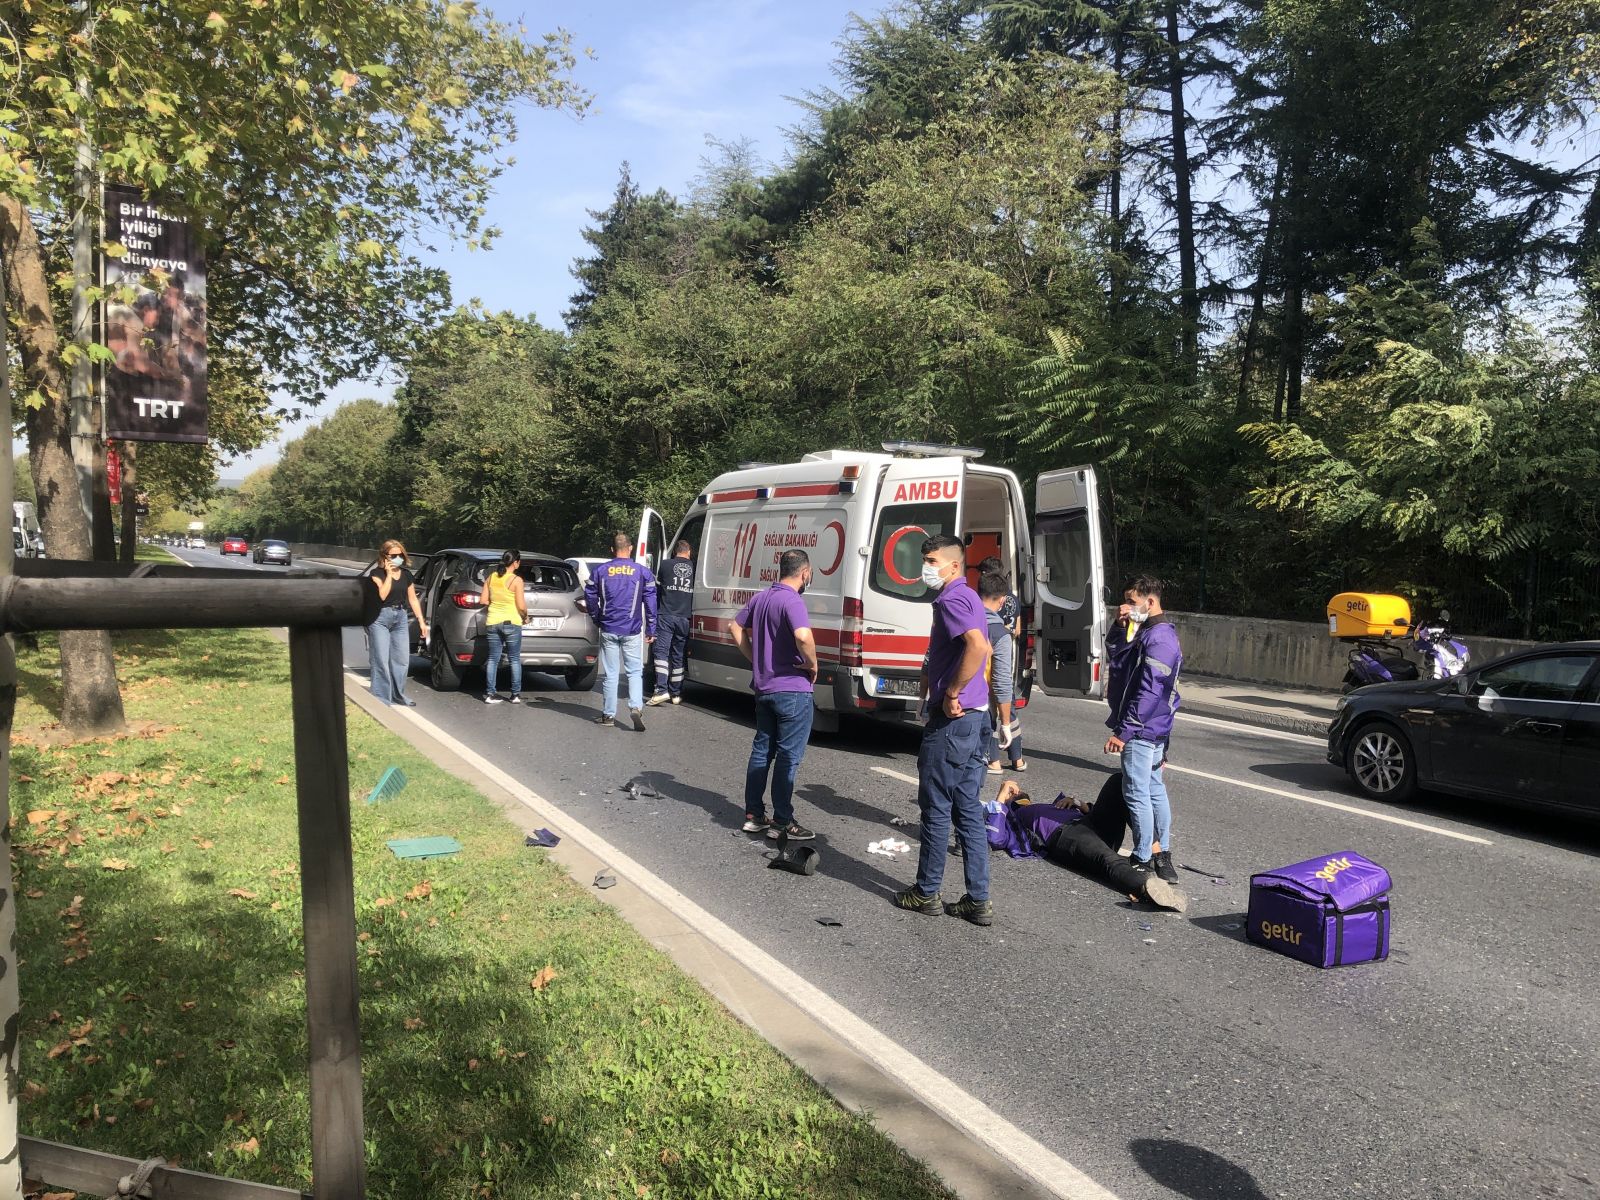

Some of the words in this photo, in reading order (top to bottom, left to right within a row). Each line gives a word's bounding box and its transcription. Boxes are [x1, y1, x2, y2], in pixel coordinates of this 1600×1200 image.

[120, 203, 142, 216] Bir
[120, 218, 162, 237] iyiliği
[120, 235, 152, 250] tüm
[121, 252, 187, 271] dünyaya
[133, 397, 184, 419] TRT
[894, 481, 958, 502] AMBU
[763, 531, 785, 547] SAĞLIK
[785, 532, 818, 547] BAKANLIĞI
[732, 523, 758, 578] 112
[608, 564, 636, 577] getir
[760, 566, 779, 582] SAĞLIK
[673, 577, 691, 587] 112
[712, 589, 726, 604] ACİL
[1347, 601, 1368, 612] getir
[1316, 857, 1352, 882] getir
[1262, 921, 1302, 945] getir
